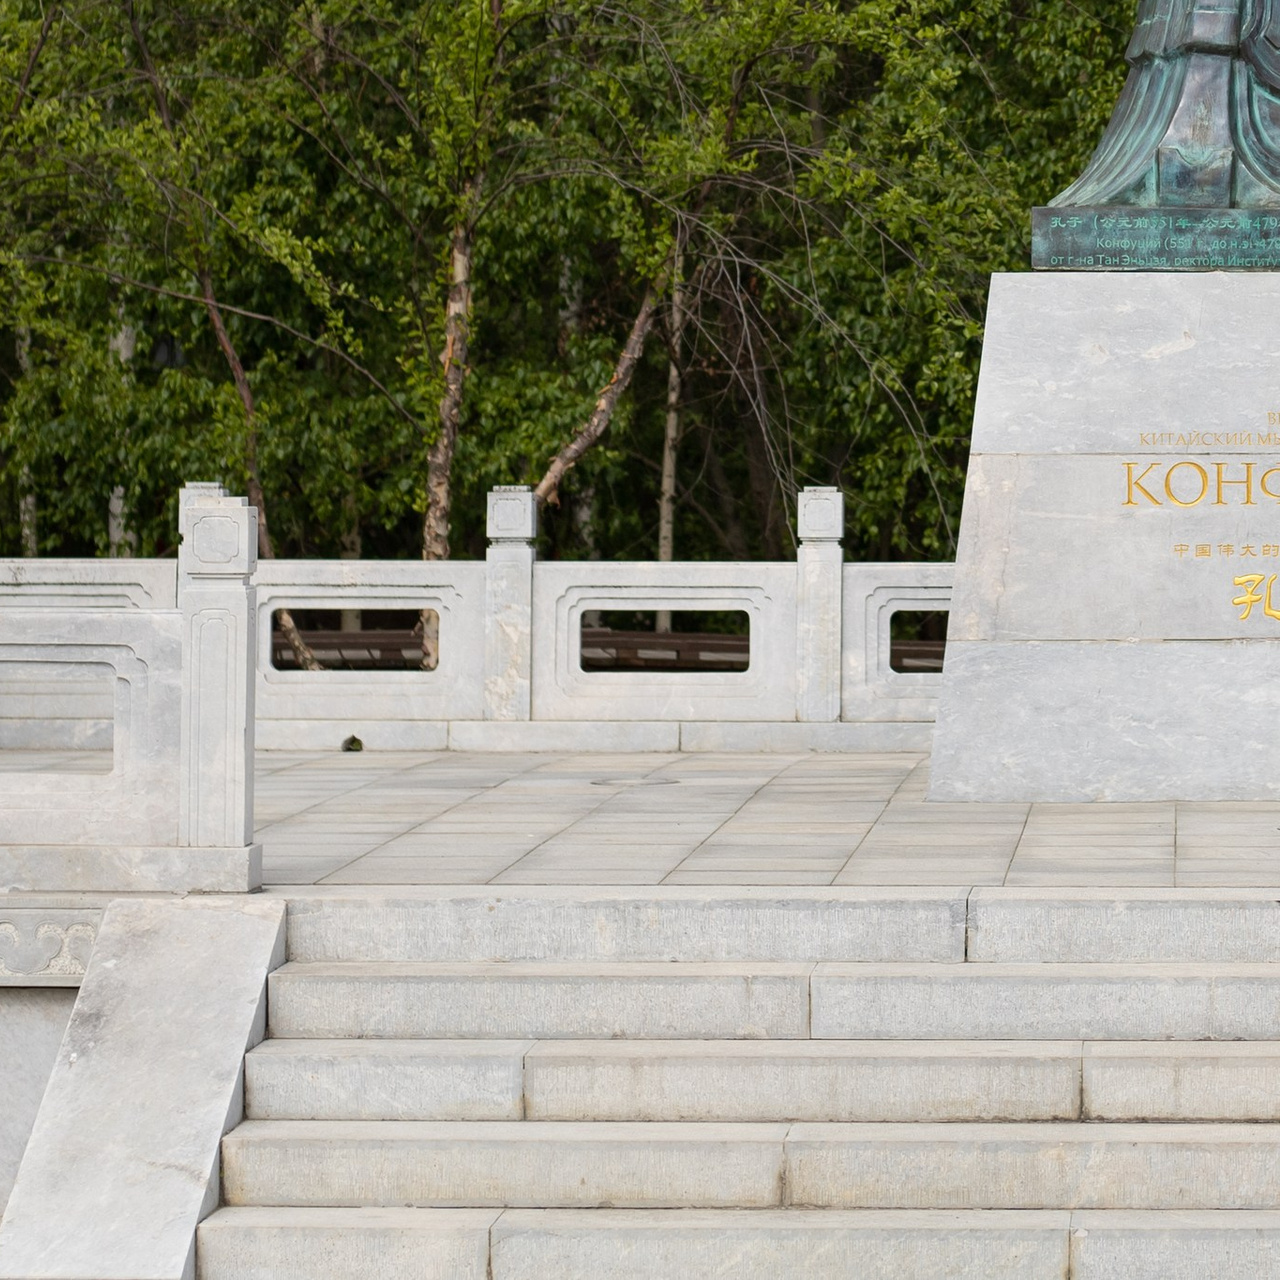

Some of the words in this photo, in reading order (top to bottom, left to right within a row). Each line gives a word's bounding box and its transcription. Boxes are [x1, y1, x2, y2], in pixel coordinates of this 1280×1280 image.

[1050, 216, 1083, 228] 孔子
[1096, 237, 1161, 250] Конфуций
[1212, 239, 1227, 250] до
[1050, 255, 1064, 265] от
[1067, 255, 1094, 265] г-на
[1096, 254, 1119, 265] Тан
[1174, 256, 1225, 267] ректора
[1139, 429, 1252, 446] КИТАЙСКИЙ
